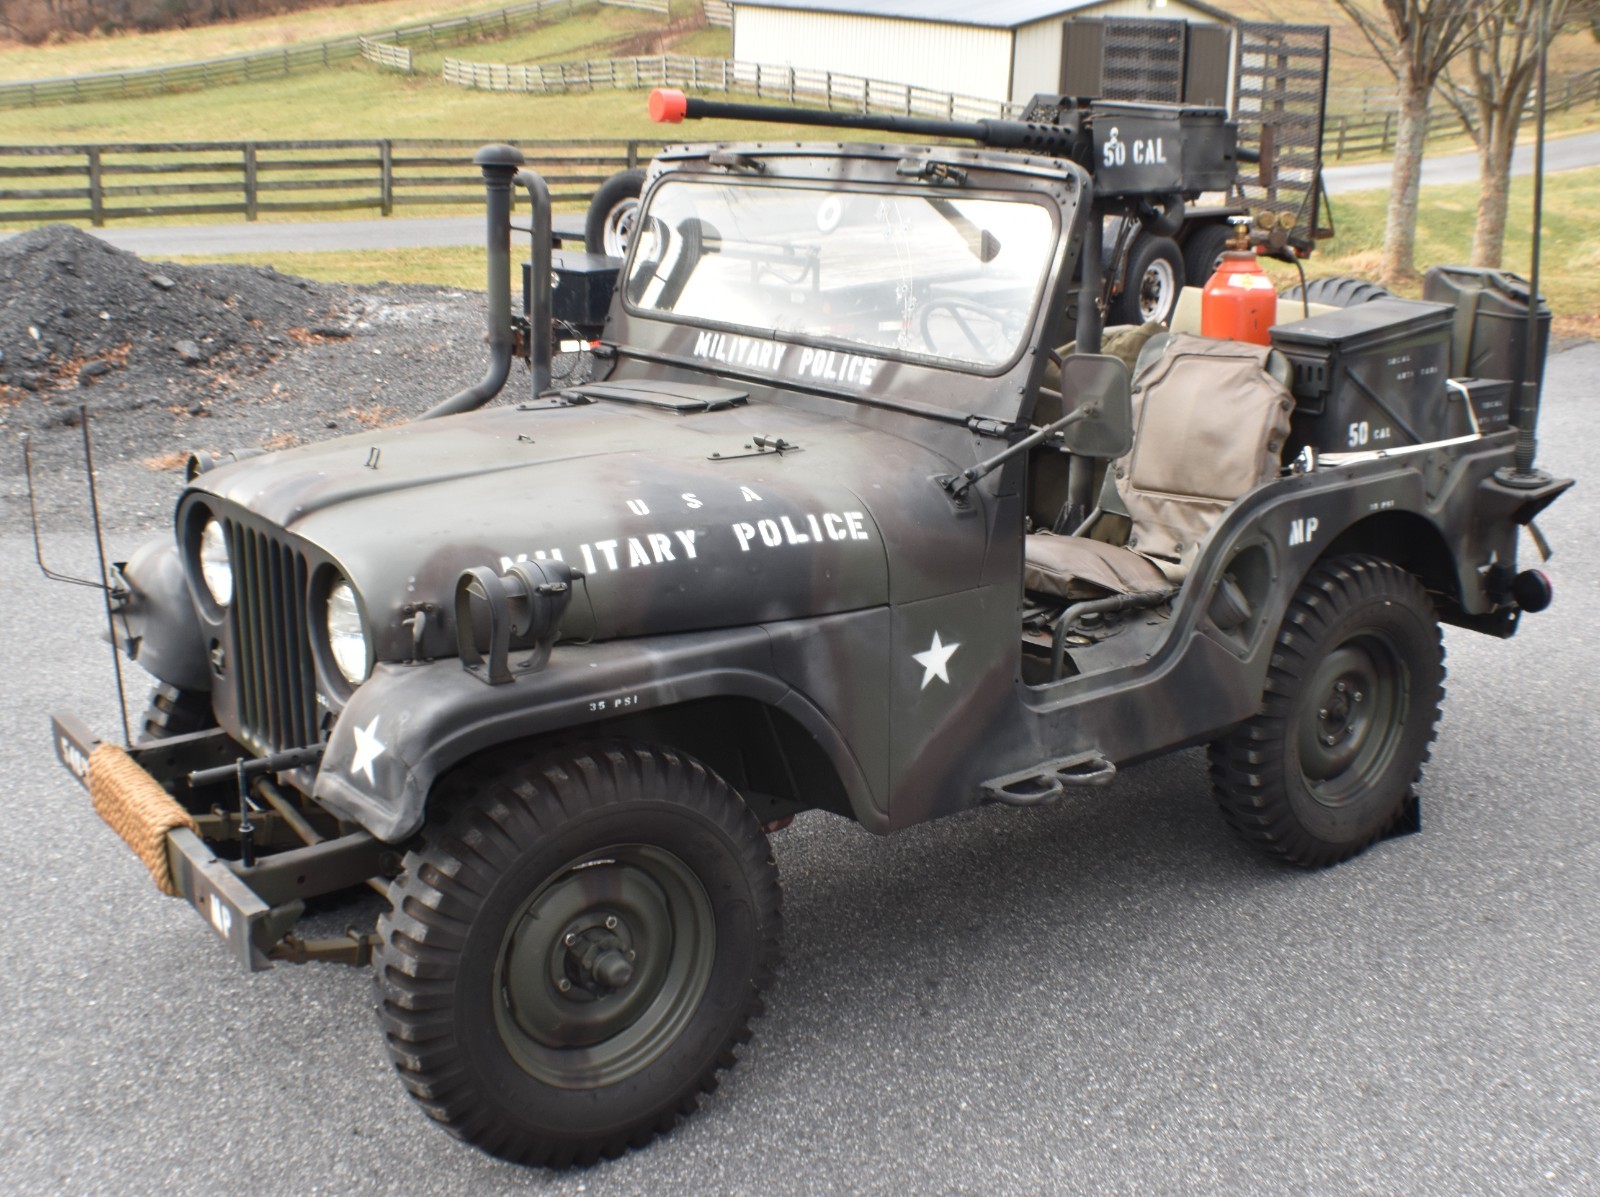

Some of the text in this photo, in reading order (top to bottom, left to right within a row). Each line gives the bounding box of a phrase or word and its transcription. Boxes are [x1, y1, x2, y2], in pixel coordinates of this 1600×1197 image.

[1103, 137, 1167, 167] 50 CAL
[693, 331, 878, 386] MILITARY POLICE
[1348, 421, 1391, 448] 50 CAL
[626, 485, 763, 516] U S A
[732, 511, 870, 552] POLICE
[1288, 517, 1319, 546] MP
[589, 694, 638, 712] 35 PSI
